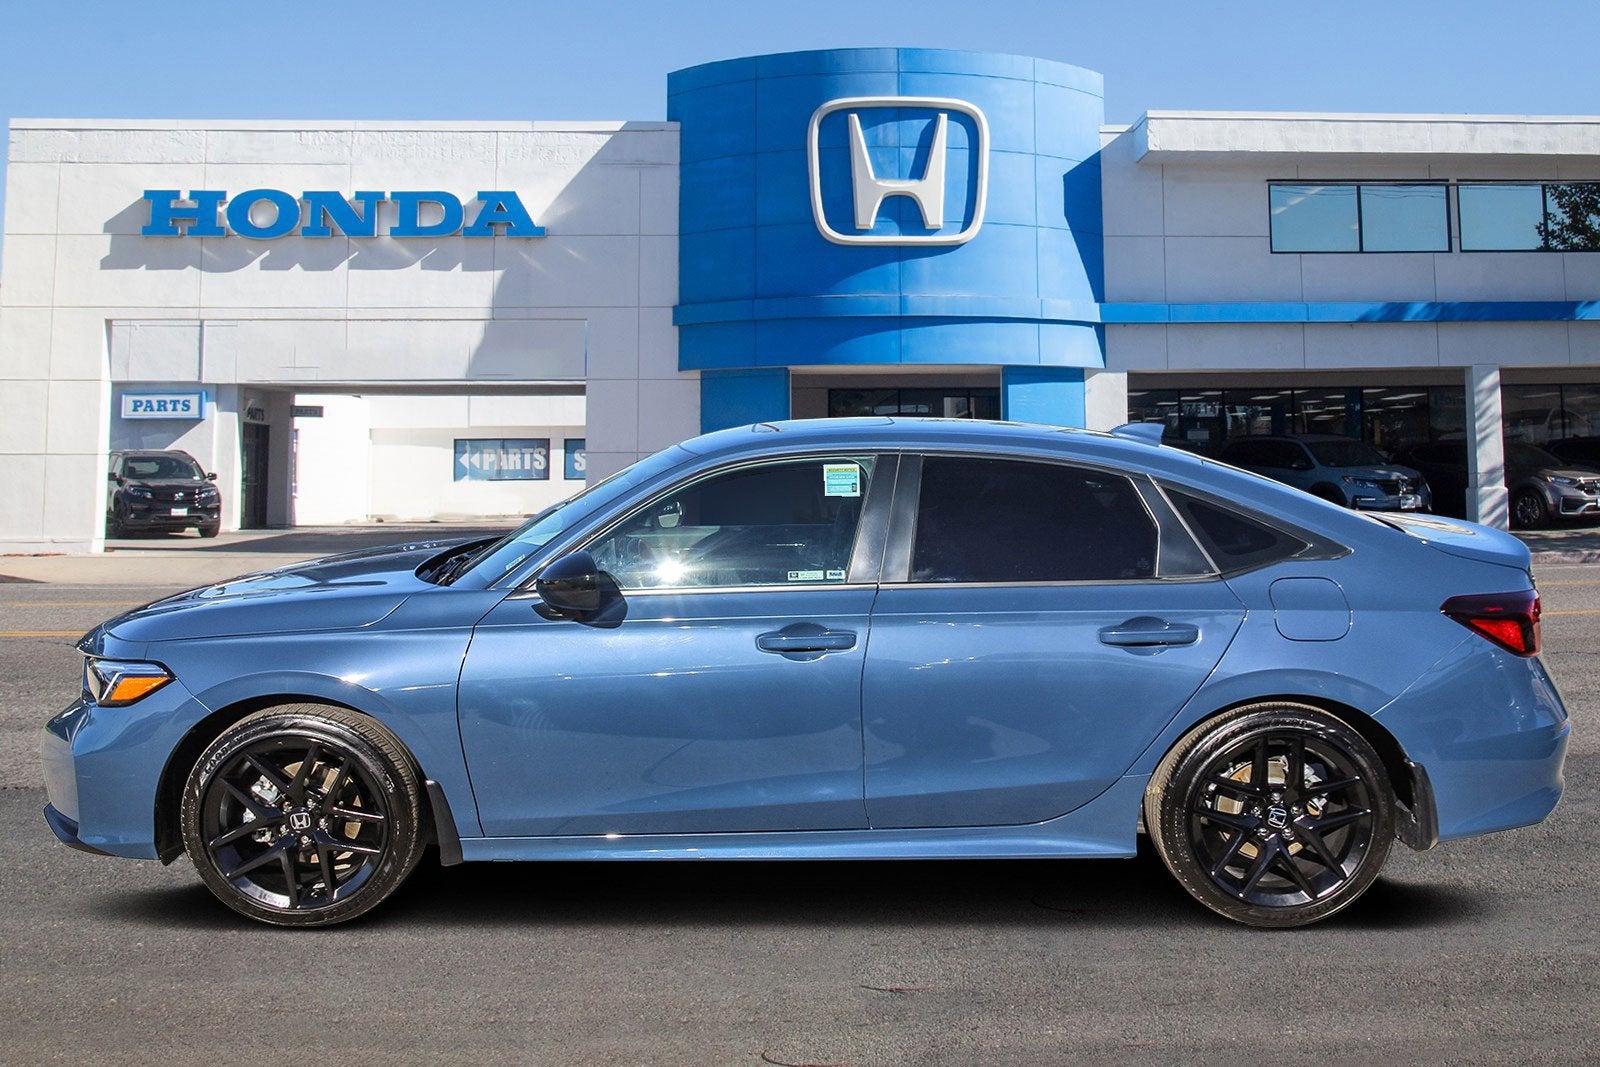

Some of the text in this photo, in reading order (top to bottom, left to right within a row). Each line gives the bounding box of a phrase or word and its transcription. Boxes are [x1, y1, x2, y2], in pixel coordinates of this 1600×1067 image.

[141, 188, 547, 240] HONDA
[132, 400, 191, 412] PARTS
[246, 407, 265, 422] PARTS
[482, 448, 547, 470] PARTS
